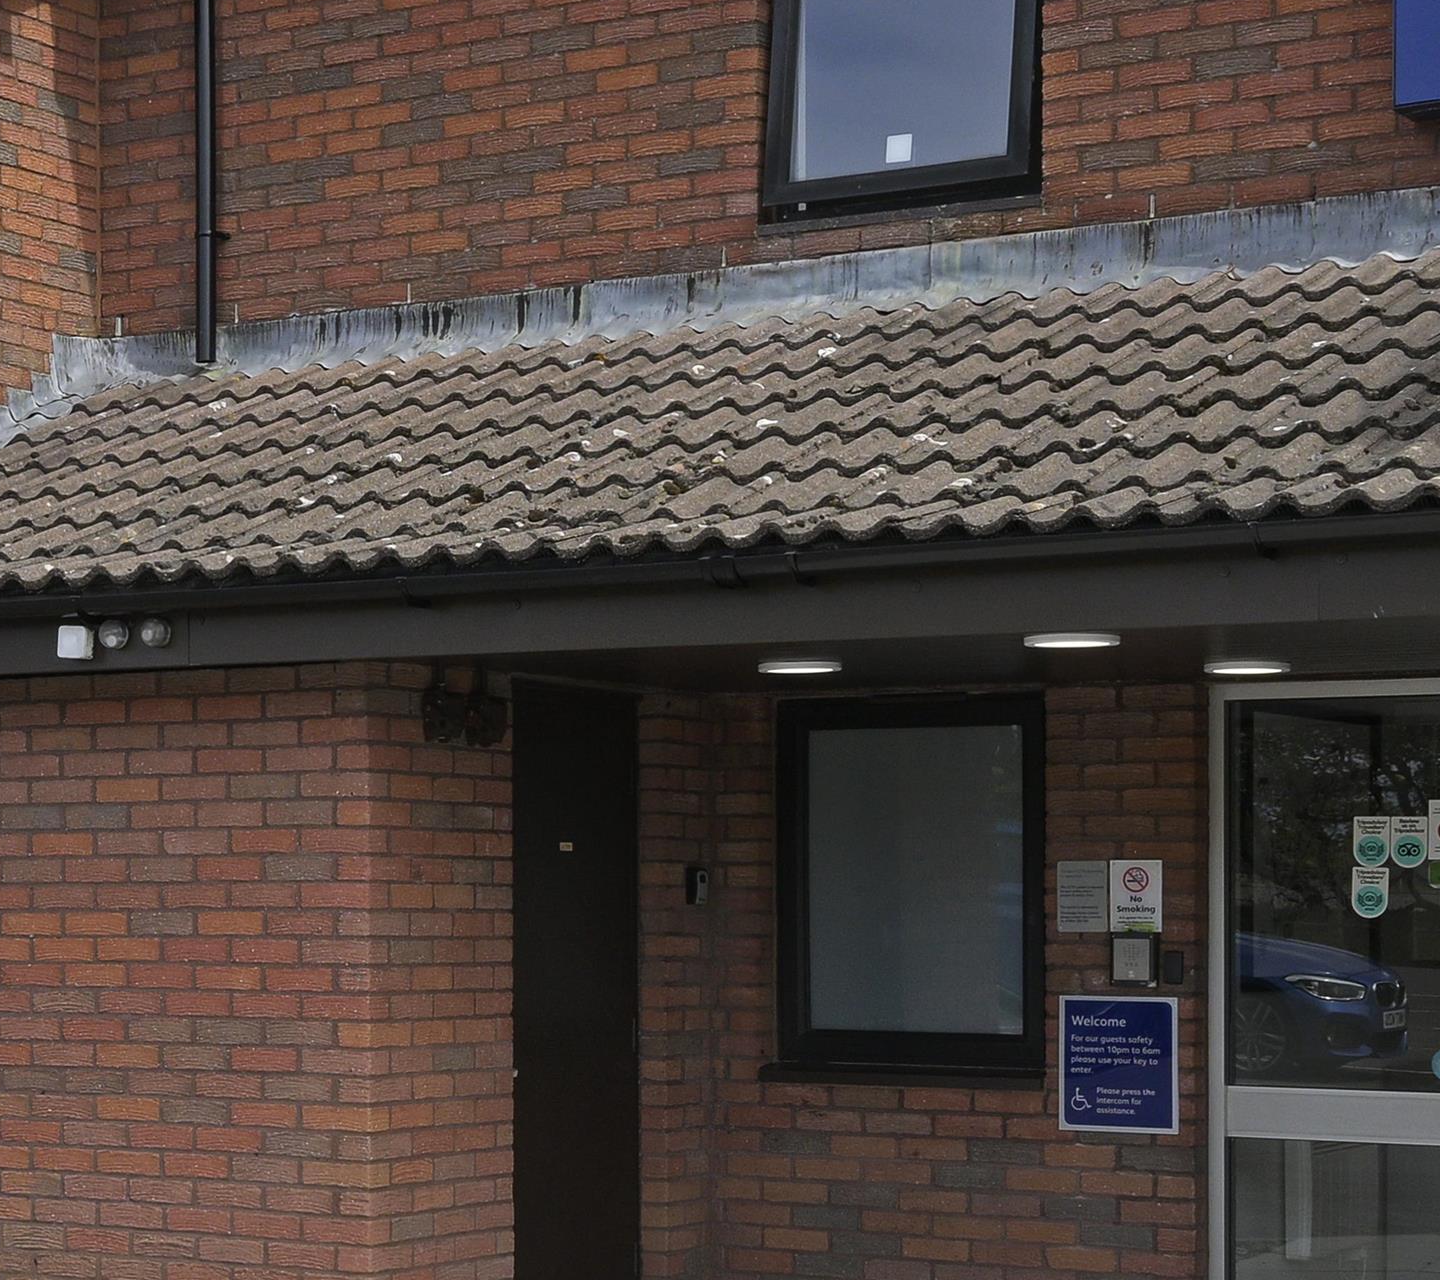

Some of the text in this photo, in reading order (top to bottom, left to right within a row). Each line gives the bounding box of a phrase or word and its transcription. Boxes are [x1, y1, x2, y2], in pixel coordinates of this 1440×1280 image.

[1129, 895, 1143, 903] No
[1116, 904, 1156, 915] Smoking
[1071, 1015, 1127, 1027] Welcome
[1071, 1034, 1084, 1042] For
[1100, 1036, 1126, 1045] guests
[1128, 1036, 1153, 1045] safety
[1071, 1045, 1105, 1053] between
[1107, 1046, 1130, 1055] 10pm
[1142, 1047, 1161, 1055] 6am
[1071, 1056, 1096, 1064] please
[1113, 1058, 1131, 1066] your
[1133, 1058, 1147, 1067] key
[1096, 1087, 1120, 1095] Please
